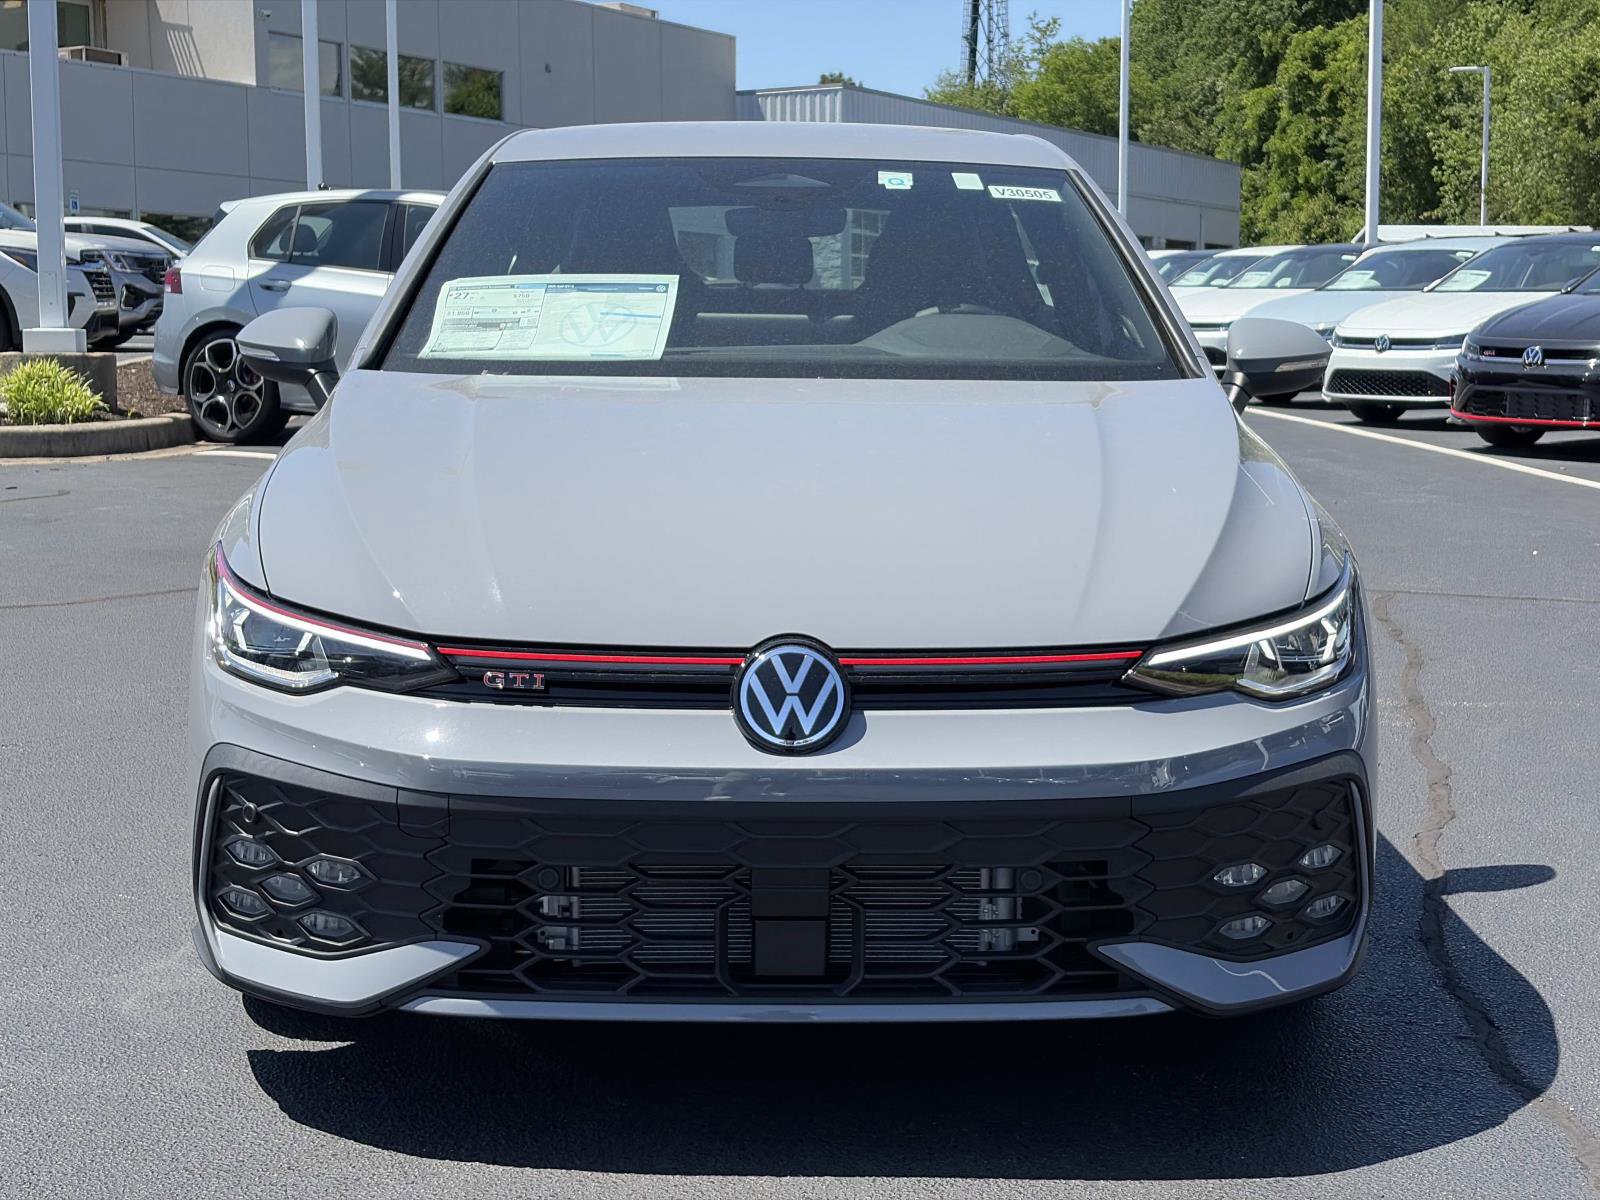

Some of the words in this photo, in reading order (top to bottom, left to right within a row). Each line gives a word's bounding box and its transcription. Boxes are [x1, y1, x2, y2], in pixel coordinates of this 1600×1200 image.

[994, 187, 1053, 200] V30505
[483, 671, 545, 690] GTI
[747, 652, 838, 738] VW
